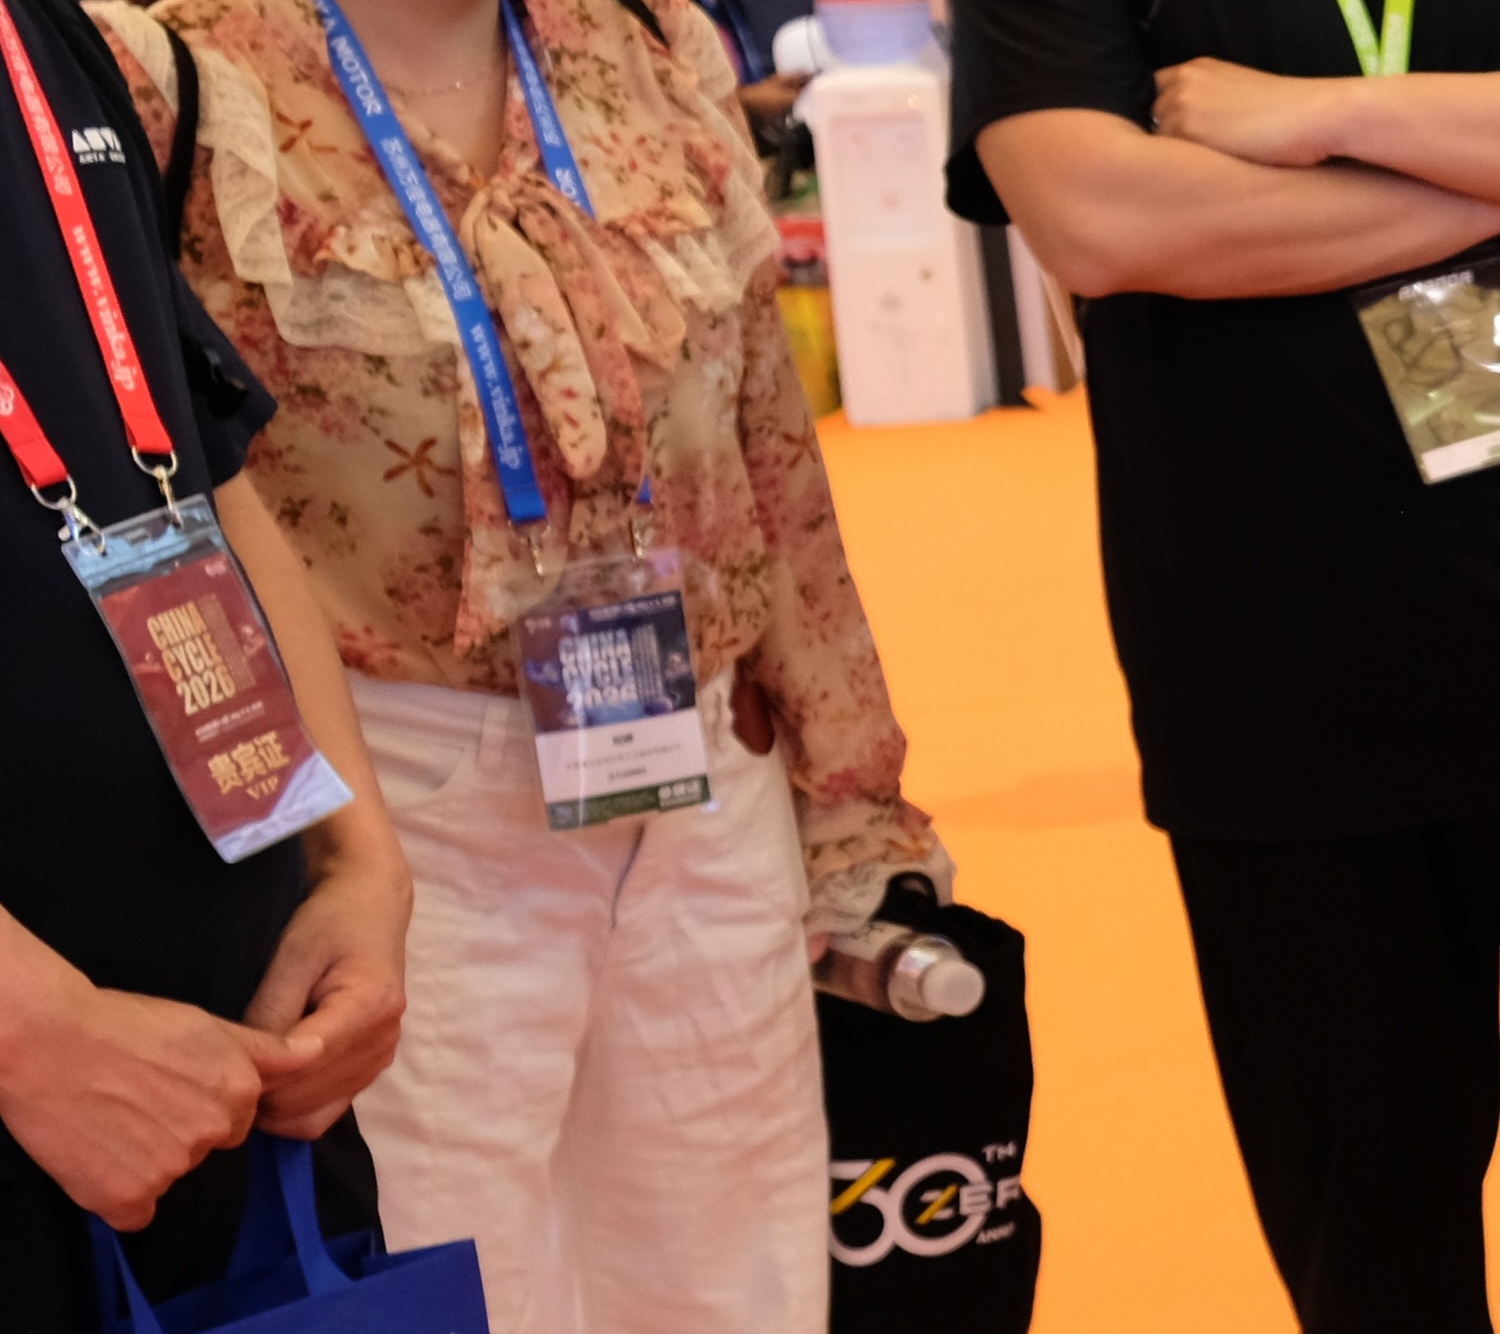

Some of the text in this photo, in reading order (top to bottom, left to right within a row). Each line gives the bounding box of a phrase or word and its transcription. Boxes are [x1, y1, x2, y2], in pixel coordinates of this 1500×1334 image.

[330, 34, 384, 117] MOTOR
[146, 600, 208, 653] CHINA
[161, 632, 225, 684] CYCLE
[176, 664, 237, 716] 2026
[245, 775, 279, 800] VIP
